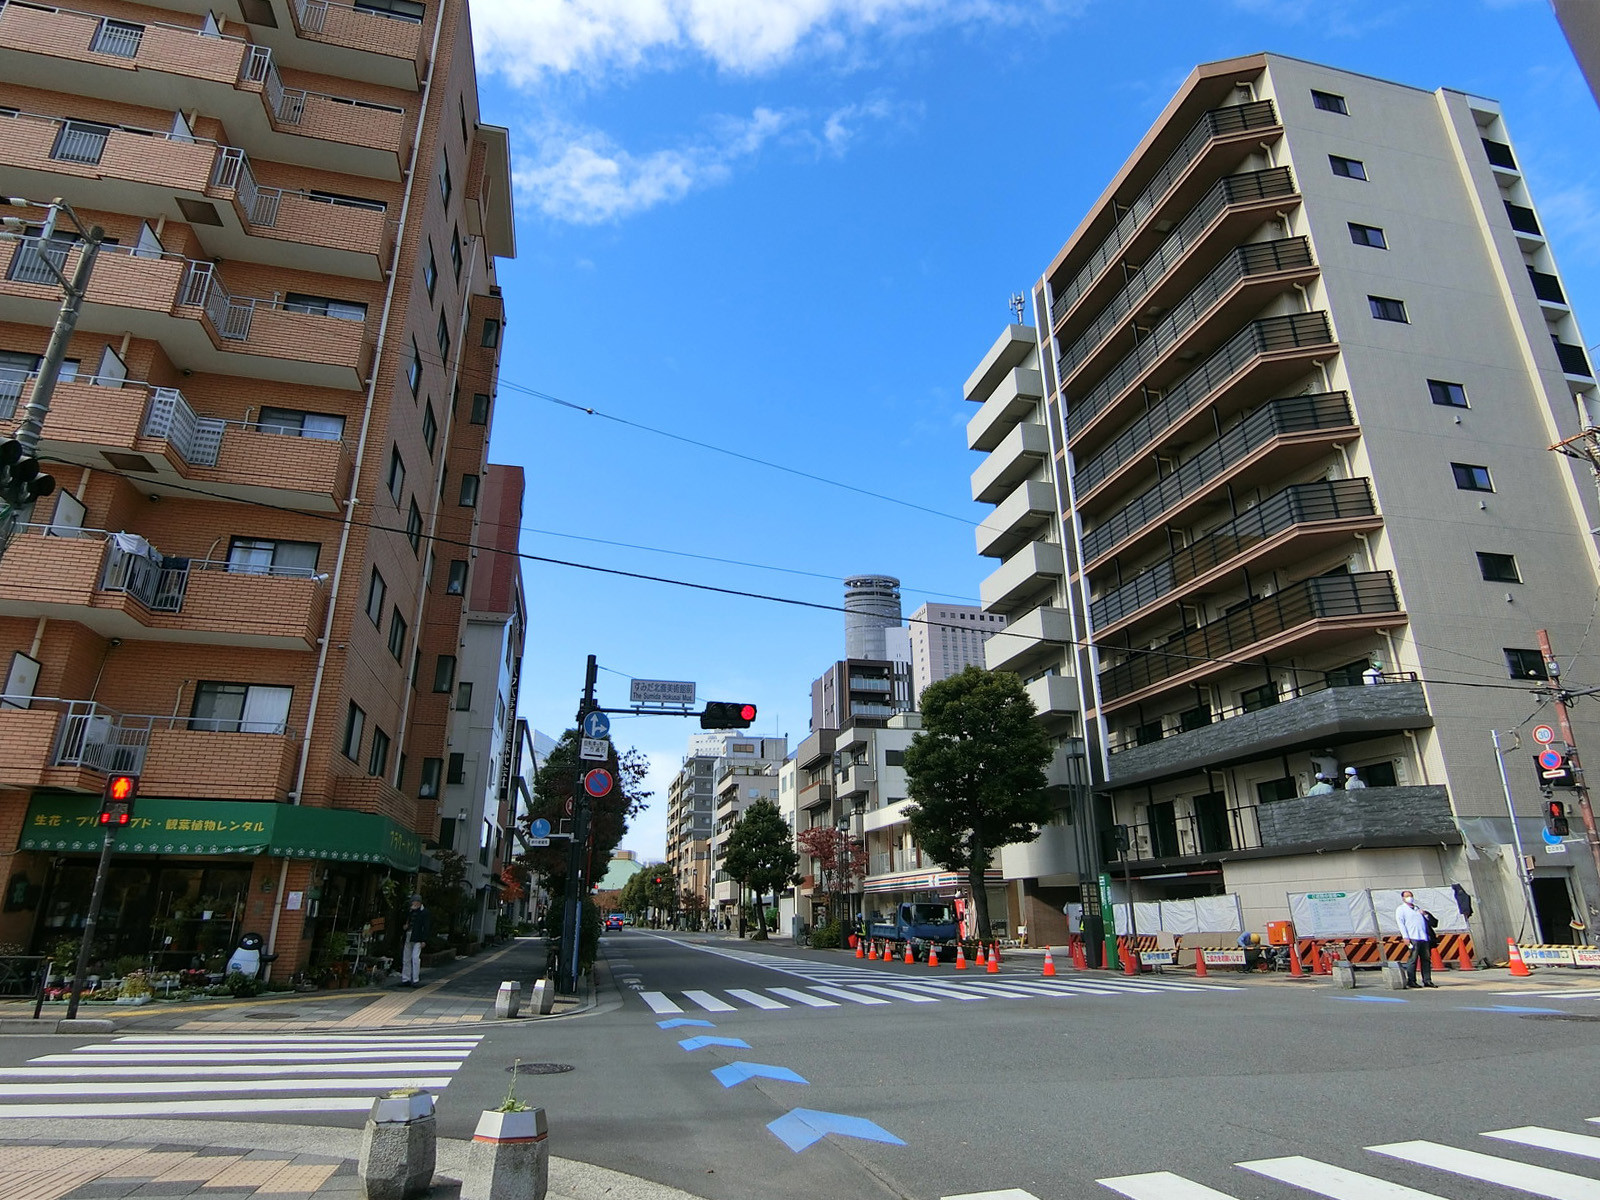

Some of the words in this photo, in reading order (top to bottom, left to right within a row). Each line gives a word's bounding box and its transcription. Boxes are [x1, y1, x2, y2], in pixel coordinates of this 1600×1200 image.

[633, 691, 642, 700] The
[643, 692, 662, 700] Sumida
[662, 693, 681, 701] Hokusai
[1538, 730, 1550, 740] 30
